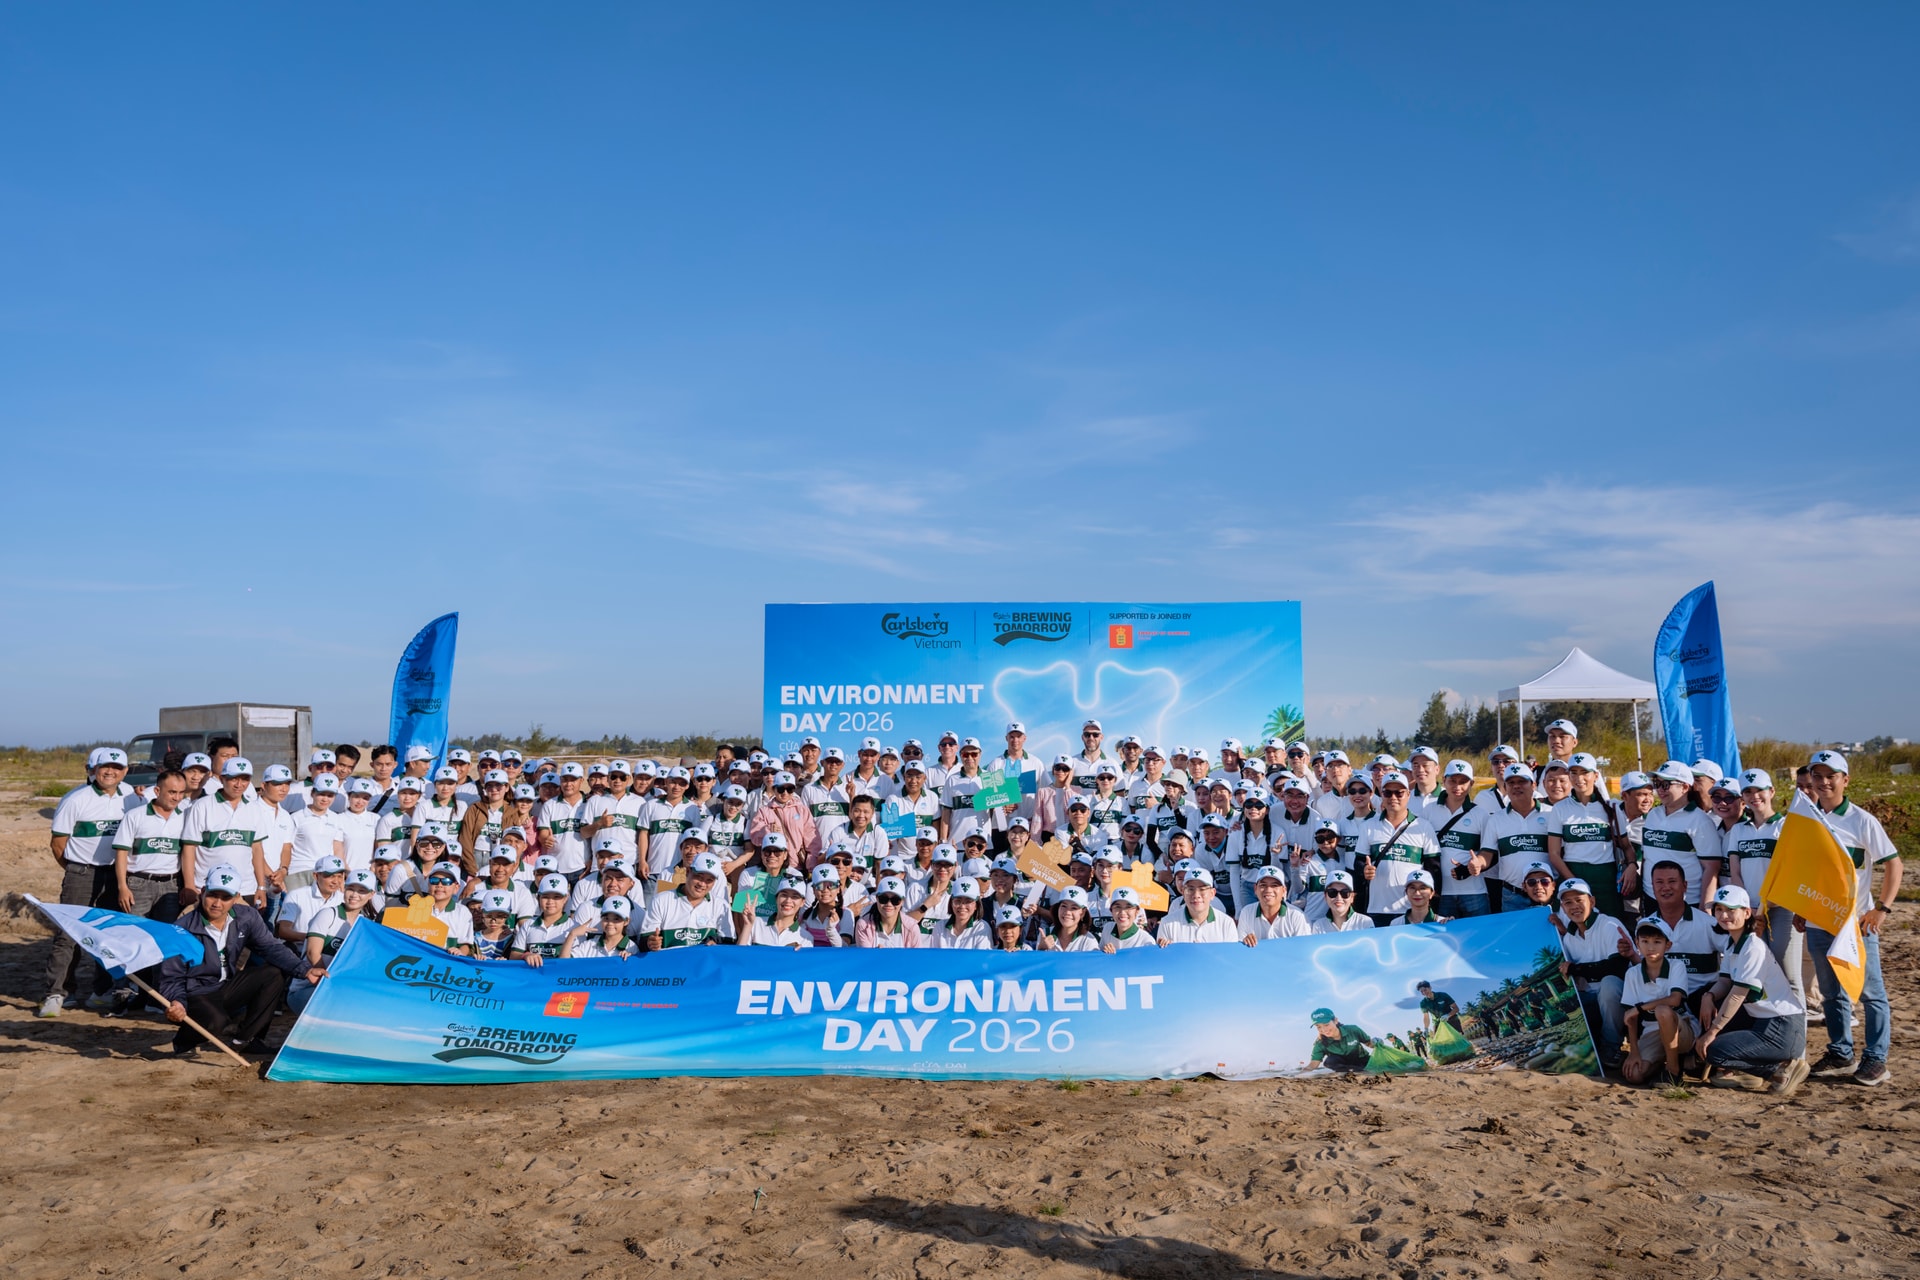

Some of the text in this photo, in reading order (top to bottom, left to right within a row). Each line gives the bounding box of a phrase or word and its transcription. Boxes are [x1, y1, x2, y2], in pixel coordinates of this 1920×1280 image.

[881, 612, 949, 640] Carlsberg
[1012, 612, 1072, 622] BREWING
[993, 623, 1071, 632] TOMORROW
[914, 637, 961, 649] Vietnam
[1686, 673, 1720, 686] BREWING
[780, 684, 984, 706] ENVIRONMENT
[780, 711, 894, 733] DAY 2026
[1570, 825, 1600, 838] Carlsberg
[1509, 836, 1538, 847] Carlsberg
[1738, 840, 1766, 853] Carlsberg
[1029, 859, 1066, 883] PROTECTING
[1031, 867, 1058, 886] NATURE
[674, 930, 702, 941] Carlsberg
[384, 954, 495, 994] Carlsberg
[557, 977, 687, 986] SUPPORTED & JOINED BY
[430, 988, 505, 1011] Vietnam
[736, 975, 1164, 1015] ENVIRONMENT
[442, 1035, 574, 1054] TOMORROW
[477, 1026, 578, 1045] BREWING
[822, 1018, 1075, 1053] DAY 2026
